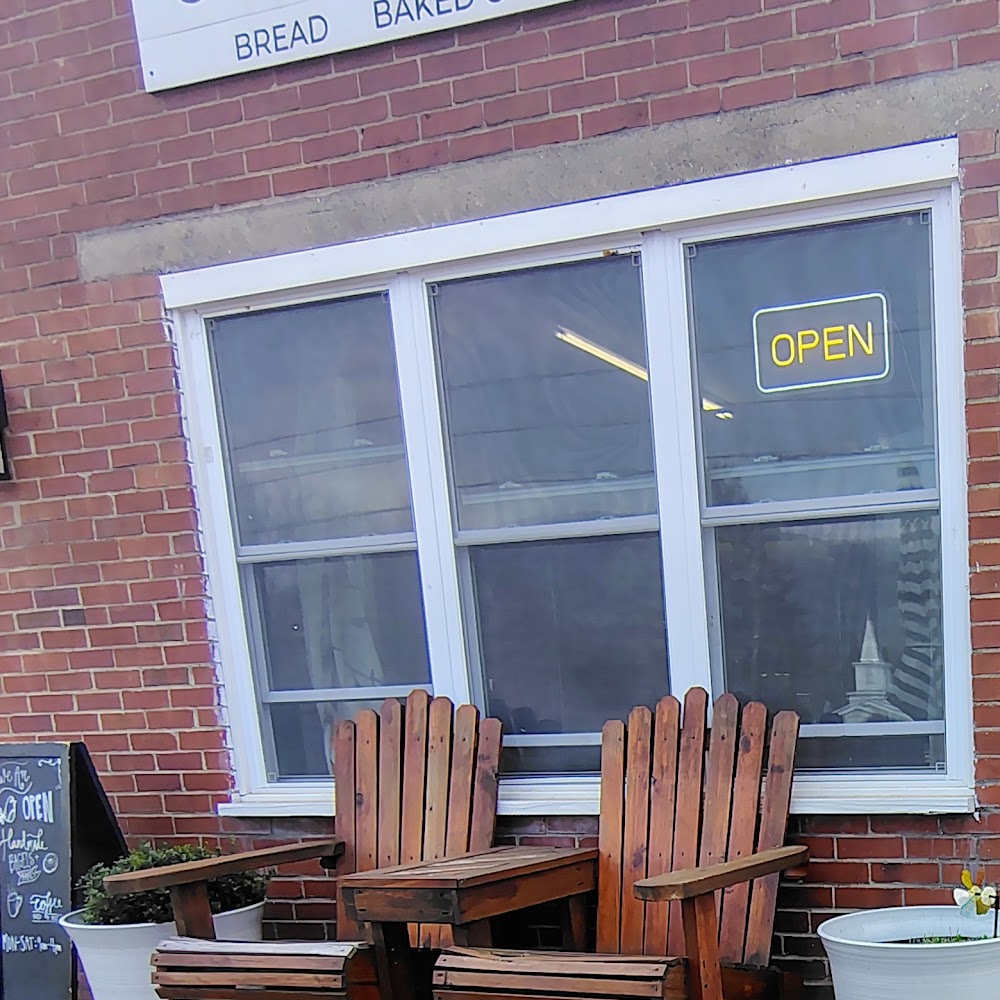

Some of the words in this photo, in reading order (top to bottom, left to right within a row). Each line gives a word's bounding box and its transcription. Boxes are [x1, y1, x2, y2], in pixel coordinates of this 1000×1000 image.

[234, 15, 329, 61] BREAD
[771, 320, 874, 367] OPEN
[22, 790, 54, 823] OPEN
